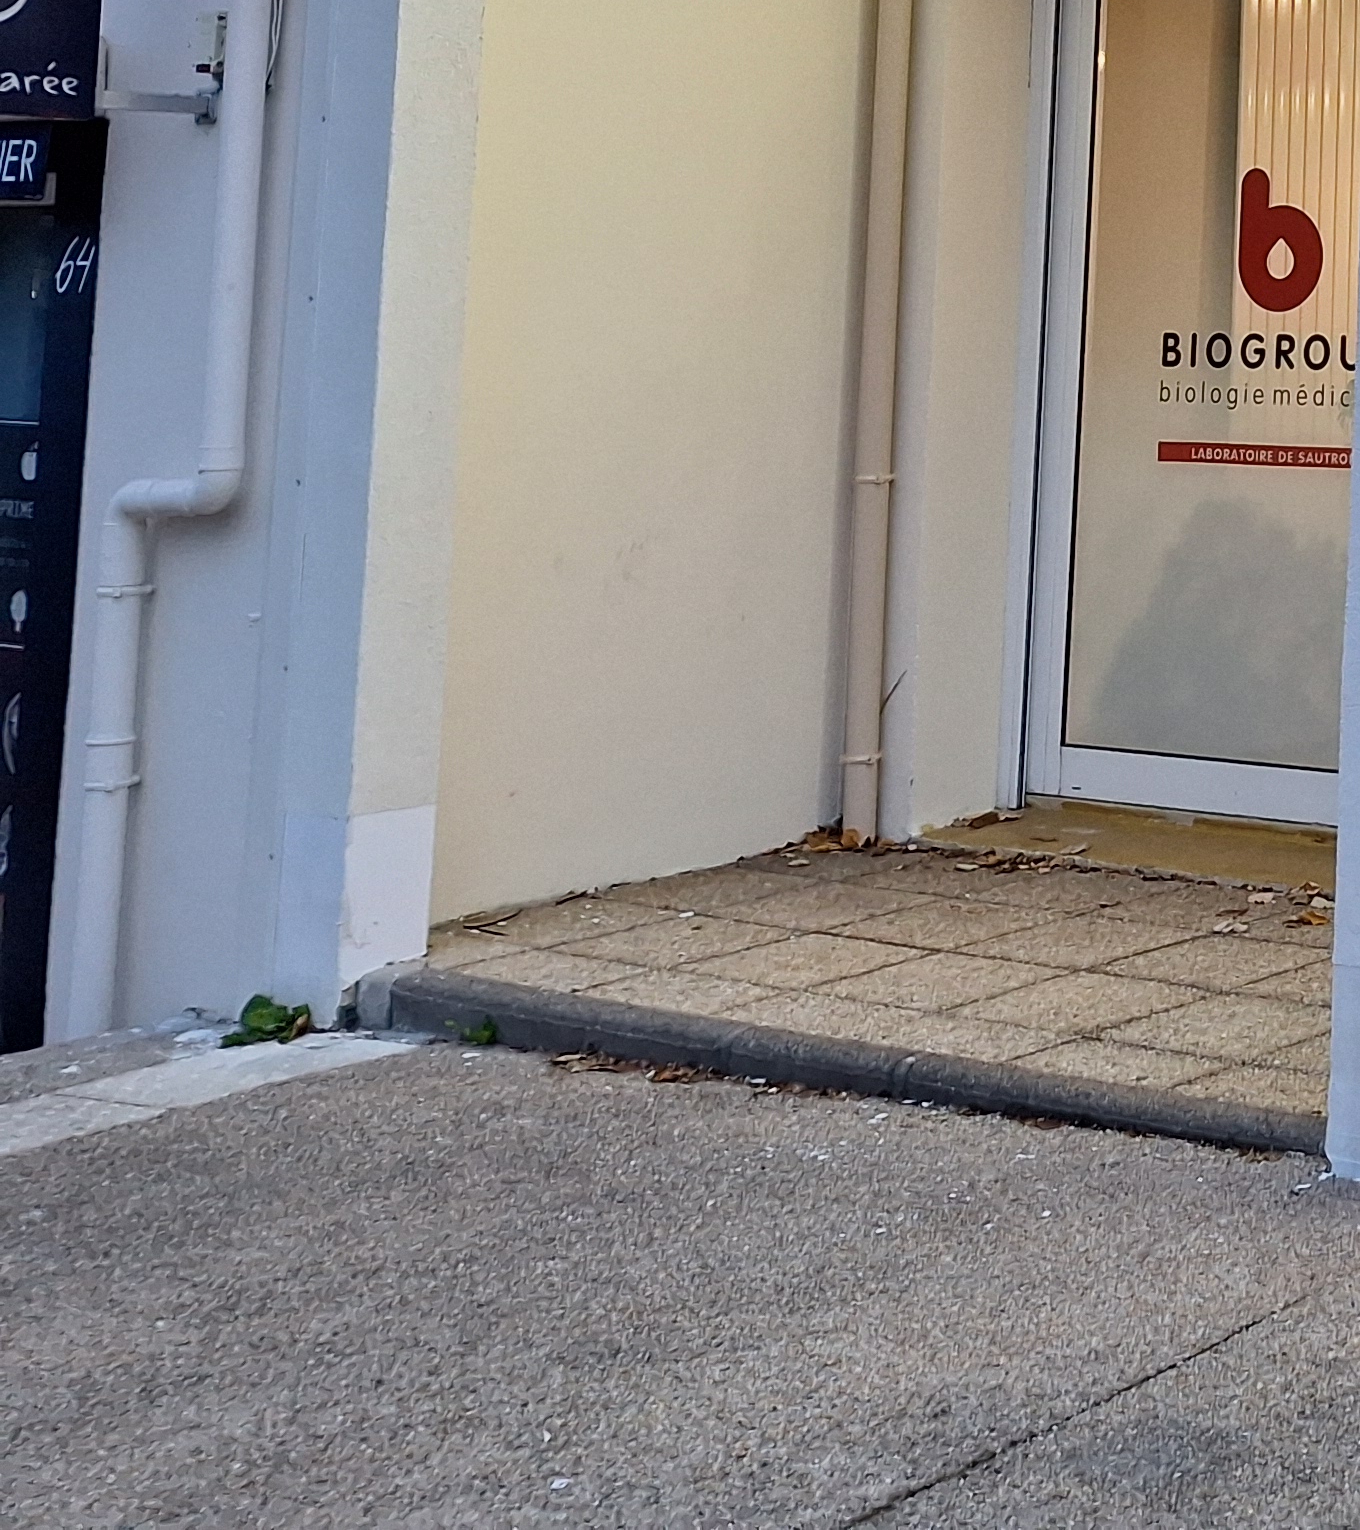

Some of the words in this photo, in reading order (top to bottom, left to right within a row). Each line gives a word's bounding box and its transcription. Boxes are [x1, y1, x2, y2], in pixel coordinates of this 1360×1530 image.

[0, 139, 37, 182] IER
[1158, 379, 1265, 411] biologie
[1273, 383, 1351, 408] médic
[1190, 446, 1274, 464] LABORATOIRE
[1277, 449, 1294, 464] DE
[1298, 450, 1351, 466] SAUTRO
